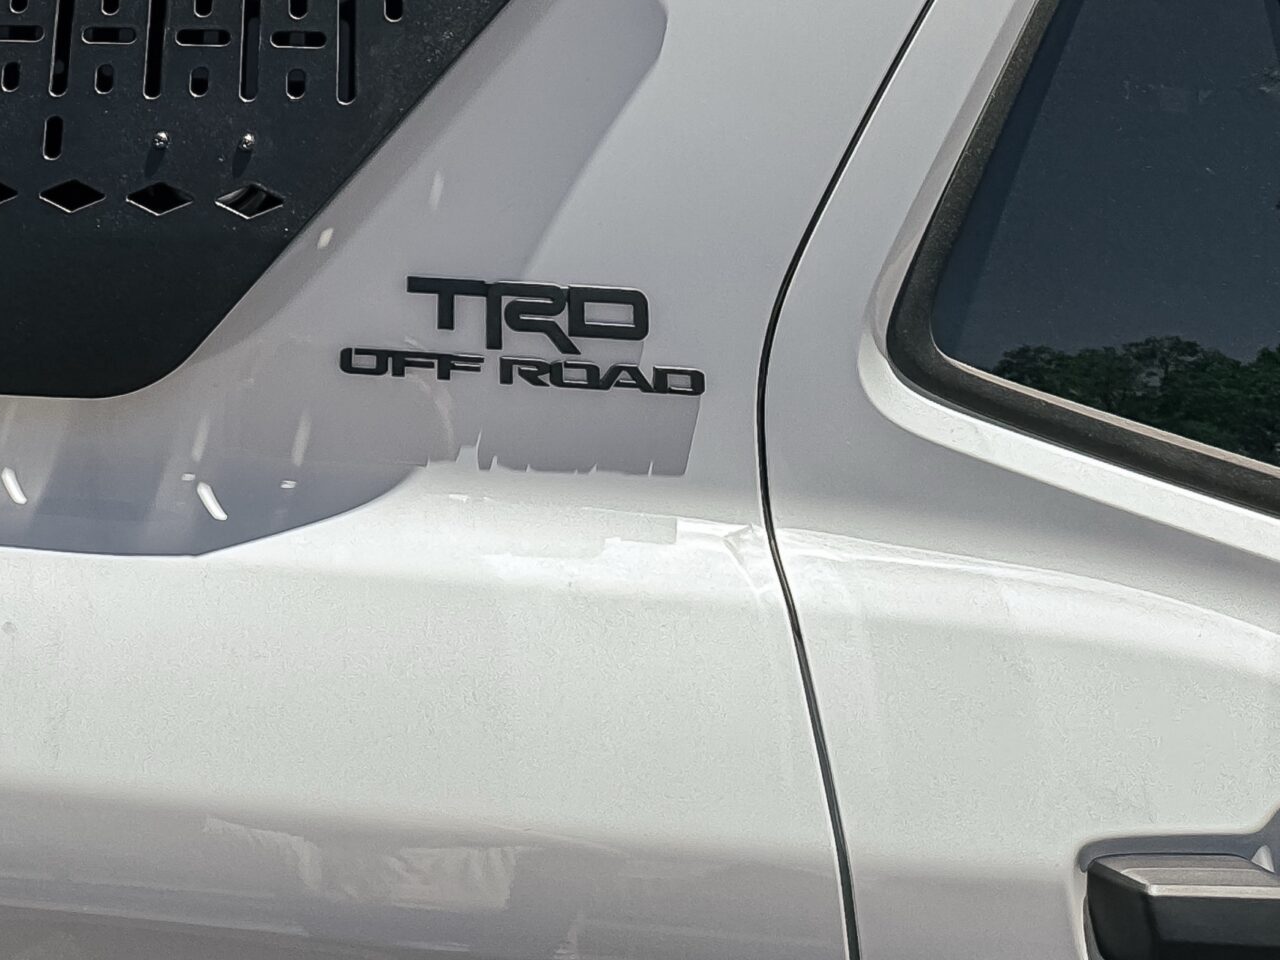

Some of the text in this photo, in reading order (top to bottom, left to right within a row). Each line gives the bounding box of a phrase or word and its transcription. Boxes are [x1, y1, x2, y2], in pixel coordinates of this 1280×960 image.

[406, 274, 650, 355] TRD
[340, 346, 706, 396] OFF ROAD
